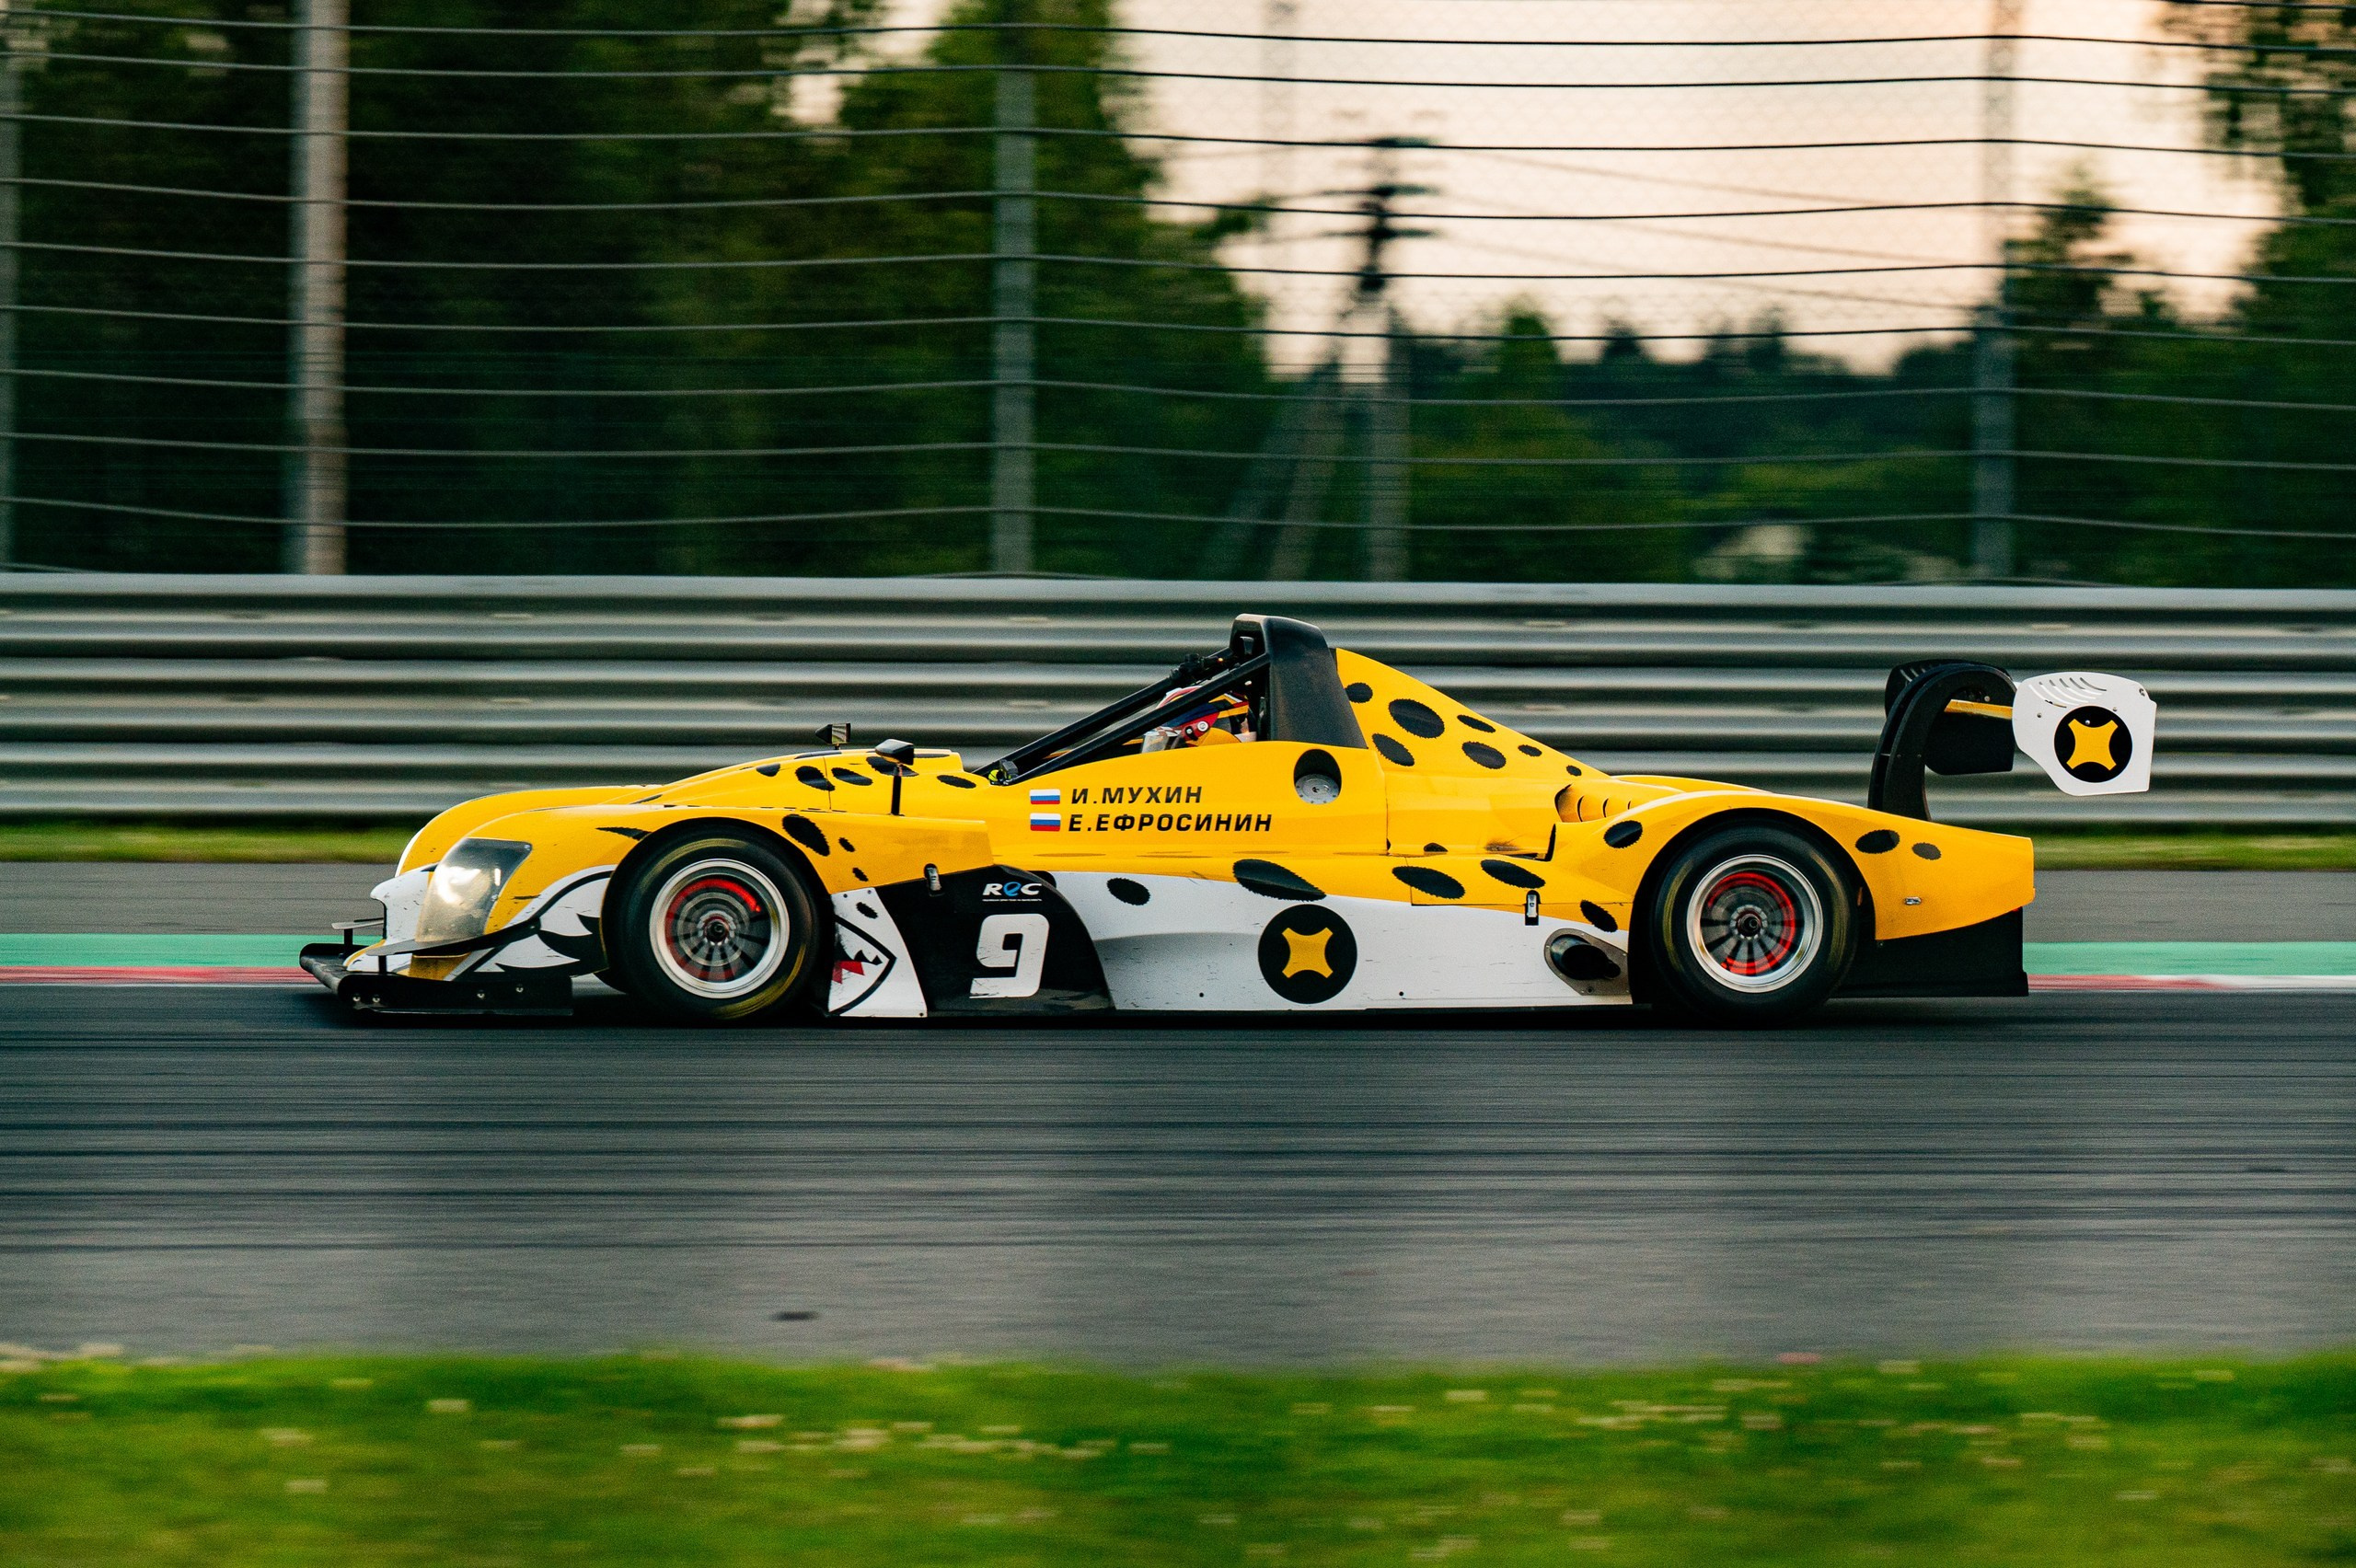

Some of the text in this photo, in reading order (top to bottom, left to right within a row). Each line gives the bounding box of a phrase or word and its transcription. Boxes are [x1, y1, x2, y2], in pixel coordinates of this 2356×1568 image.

[1071, 786, 1202, 804] И.МУХИН
[1068, 813, 1272, 832] Е.ЕФРОСИНИН
[969, 913, 1050, 999] 9
